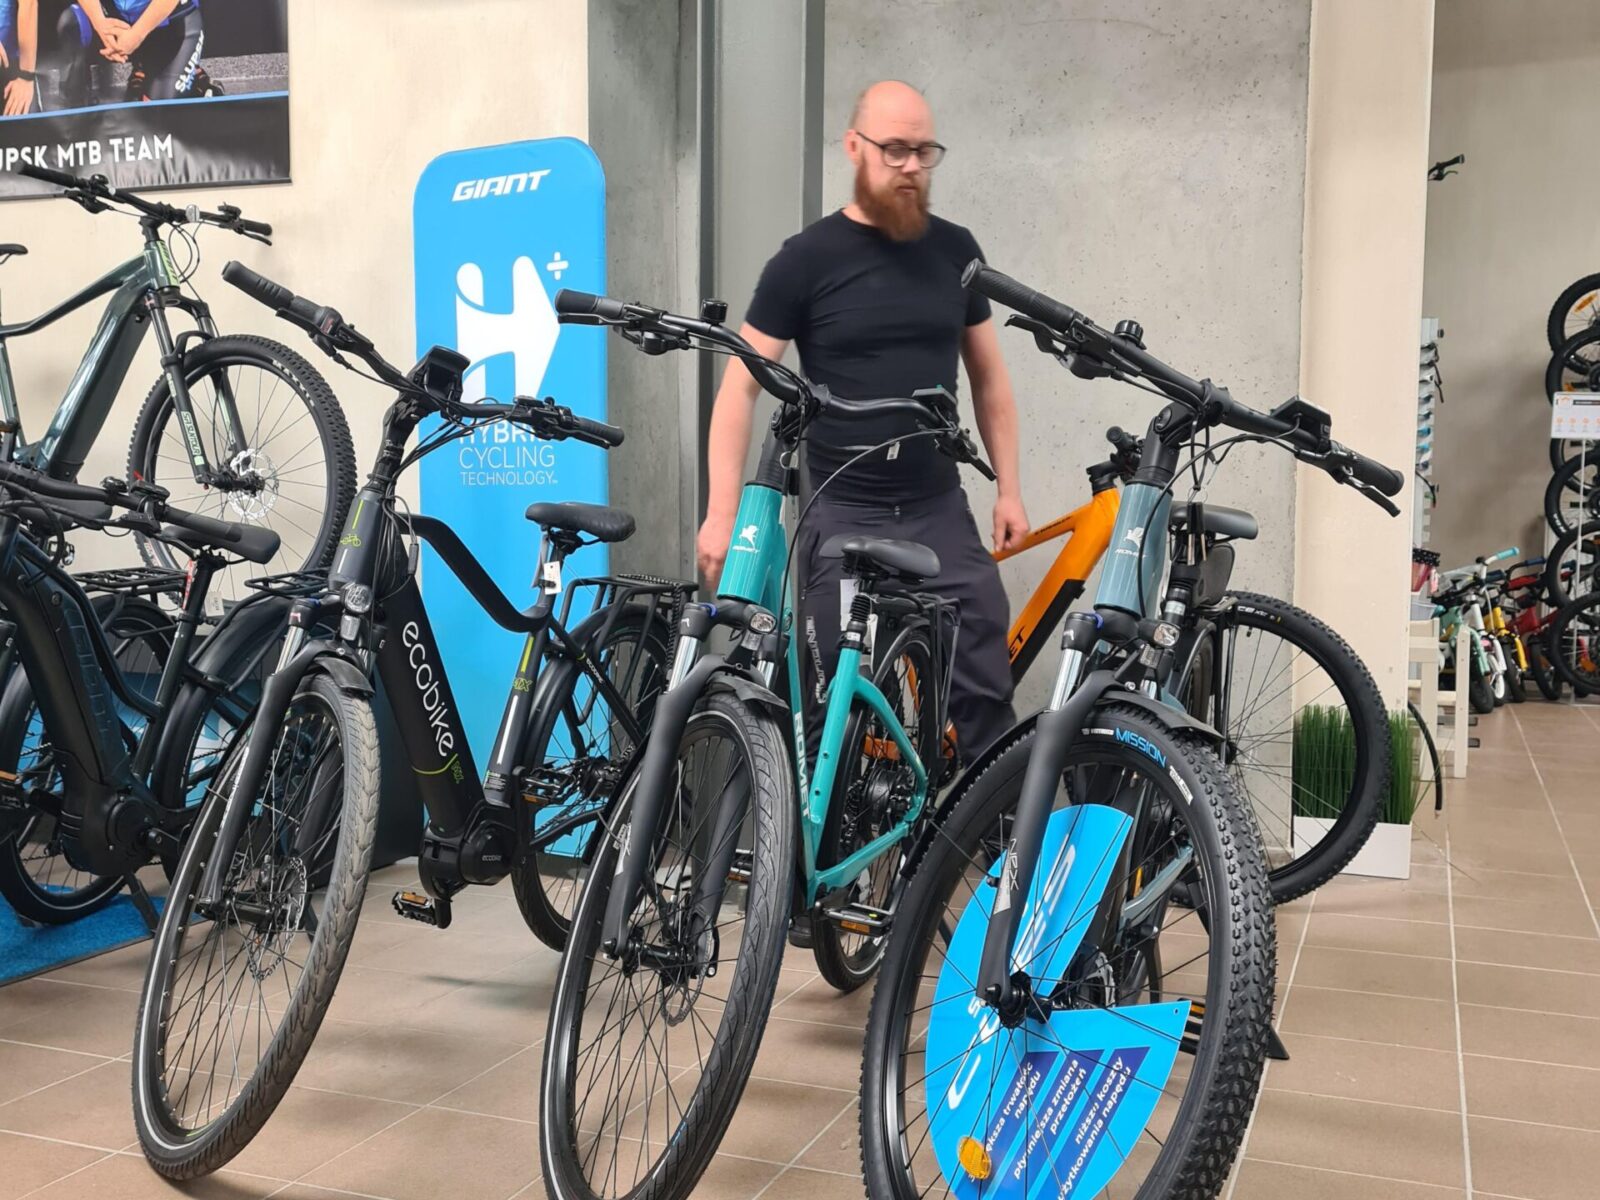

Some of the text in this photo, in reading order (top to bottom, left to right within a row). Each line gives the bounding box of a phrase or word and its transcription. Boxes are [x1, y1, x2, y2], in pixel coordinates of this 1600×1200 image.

[57, 141, 102, 168] MTB
[109, 133, 173, 163] TEAM
[451, 168, 552, 202] GIANT
[459, 418, 550, 444] YBRI
[459, 444, 555, 469] CYCLING
[460, 470, 554, 486] TECHNOLOGY
[402, 621, 454, 757] ecobike
[794, 711, 810, 819] ROMET
[1115, 727, 1167, 769] MISSION
[1051, 1058, 1079, 1107] zmiana
[1096, 1056, 1124, 1103] koszty
